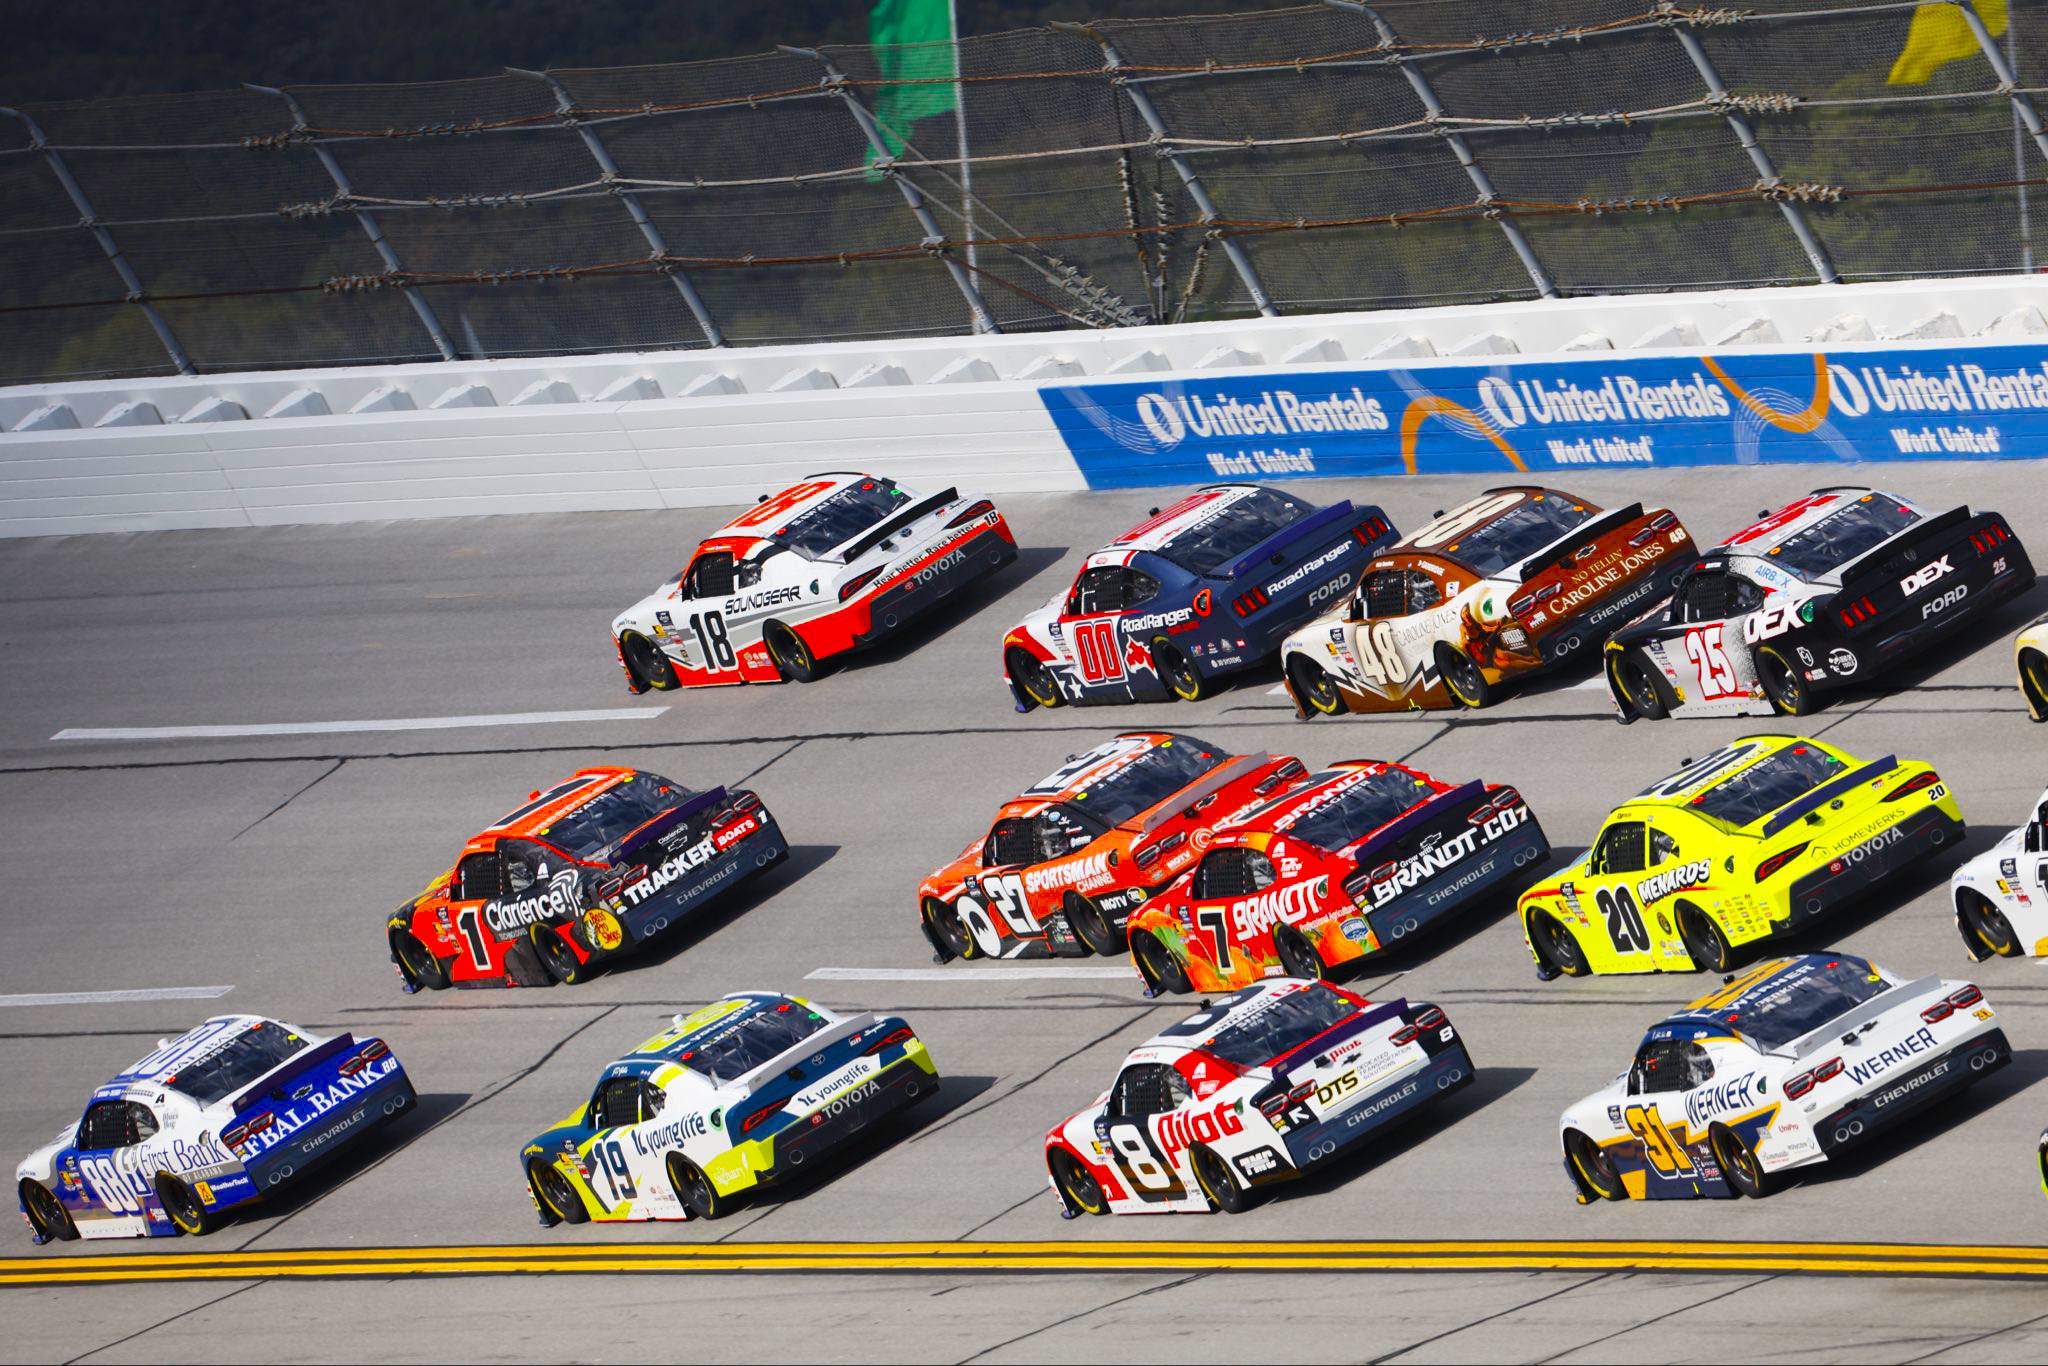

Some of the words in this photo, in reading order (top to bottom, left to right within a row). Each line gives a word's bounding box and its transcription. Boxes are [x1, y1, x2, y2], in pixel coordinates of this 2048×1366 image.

[1519, 376, 1626, 424] United
[1615, 372, 1730, 419] Rentals
[1861, 365, 1973, 412] United
[1178, 391, 1288, 438] United
[1275, 387, 1389, 434] Rentals
[1206, 450, 1259, 476] Work
[1252, 448, 1315, 473] United
[1547, 438, 1597, 464] Work
[1592, 435, 1653, 462] United
[1890, 427, 1943, 453] Work
[1936, 426, 2000, 453] United
[983, 511, 999, 526] 18
[1668, 527, 1687, 545] 48
[914, 548, 966, 585] TOYOTA
[1549, 567, 1622, 615] CAROLINE
[1621, 541, 1665, 576] JONES
[1571, 570, 1590, 586] NO
[1900, 553, 1955, 598] DEX
[1992, 557, 2007, 576] 25
[724, 585, 801, 616] SOUNDGEAR
[1308, 573, 1351, 607] FORD
[1589, 581, 1654, 625] CHEVROLET
[1922, 584, 1968, 620] FORD
[689, 610, 737, 673] 18
[1743, 600, 1806, 645] DEX
[1074, 622, 1124, 682] 00
[1355, 621, 1408, 686] 48
[1685, 624, 1738, 699] 25
[1273, 763, 1381, 834] BRANDT
[1515, 806, 1529, 823] 7
[1927, 784, 1946, 801] 20
[757, 810, 768, 824] 1
[1832, 807, 1906, 853] HOMEWERKS
[623, 836, 719, 905] TRACKER
[717, 819, 755, 846] BOATS
[1399, 852, 1419, 869] Grow
[1418, 845, 1434, 859] with
[1841, 827, 1904, 868] TOYOTA
[676, 861, 739, 906] CHEVROLET
[1024, 851, 1110, 894] SPORTSMAN
[1076, 871, 1115, 894] CHANNEL
[1427, 860, 1496, 906] CHEVROLET
[1637, 859, 1711, 905] MENARDS
[486, 889, 566, 933] Clarience
[983, 874, 1043, 934] 27
[1100, 895, 1128, 912] MOTV
[1233, 874, 1329, 942] BRANDT
[1596, 886, 1651, 953] 20
[457, 907, 492, 971] 1
[1197, 905, 1236, 975] 7
[1724, 963, 1815, 1010] WERNER
[1439, 1025, 1454, 1043] 8
[1972, 1008, 1995, 1022] 31
[382, 1057, 398, 1074] 88
[1843, 1026, 1938, 1086] WERNER
[816, 1062, 871, 1100] younglife
[822, 1080, 881, 1121] TOYOTA
[1316, 1071, 1359, 1105] DTS
[1683, 1072, 1755, 1129] WERNER
[1874, 1062, 1950, 1109] CHEVROLET
[248, 1060, 384, 1160] FBAL.BANK
[1346, 1081, 1418, 1127] CHEVROLET
[302, 1108, 366, 1153] CHEVROLET
[647, 1111, 707, 1158] younglife
[1625, 1103, 1695, 1174] 31
[139, 1143, 174, 1177] First
[173, 1132, 230, 1172] Bank
[593, 1140, 637, 1201] 19
[1110, 1124, 1171, 1189] 8
[79, 1156, 141, 1212] 88
[209, 1176, 249, 1192] WeatherTech
